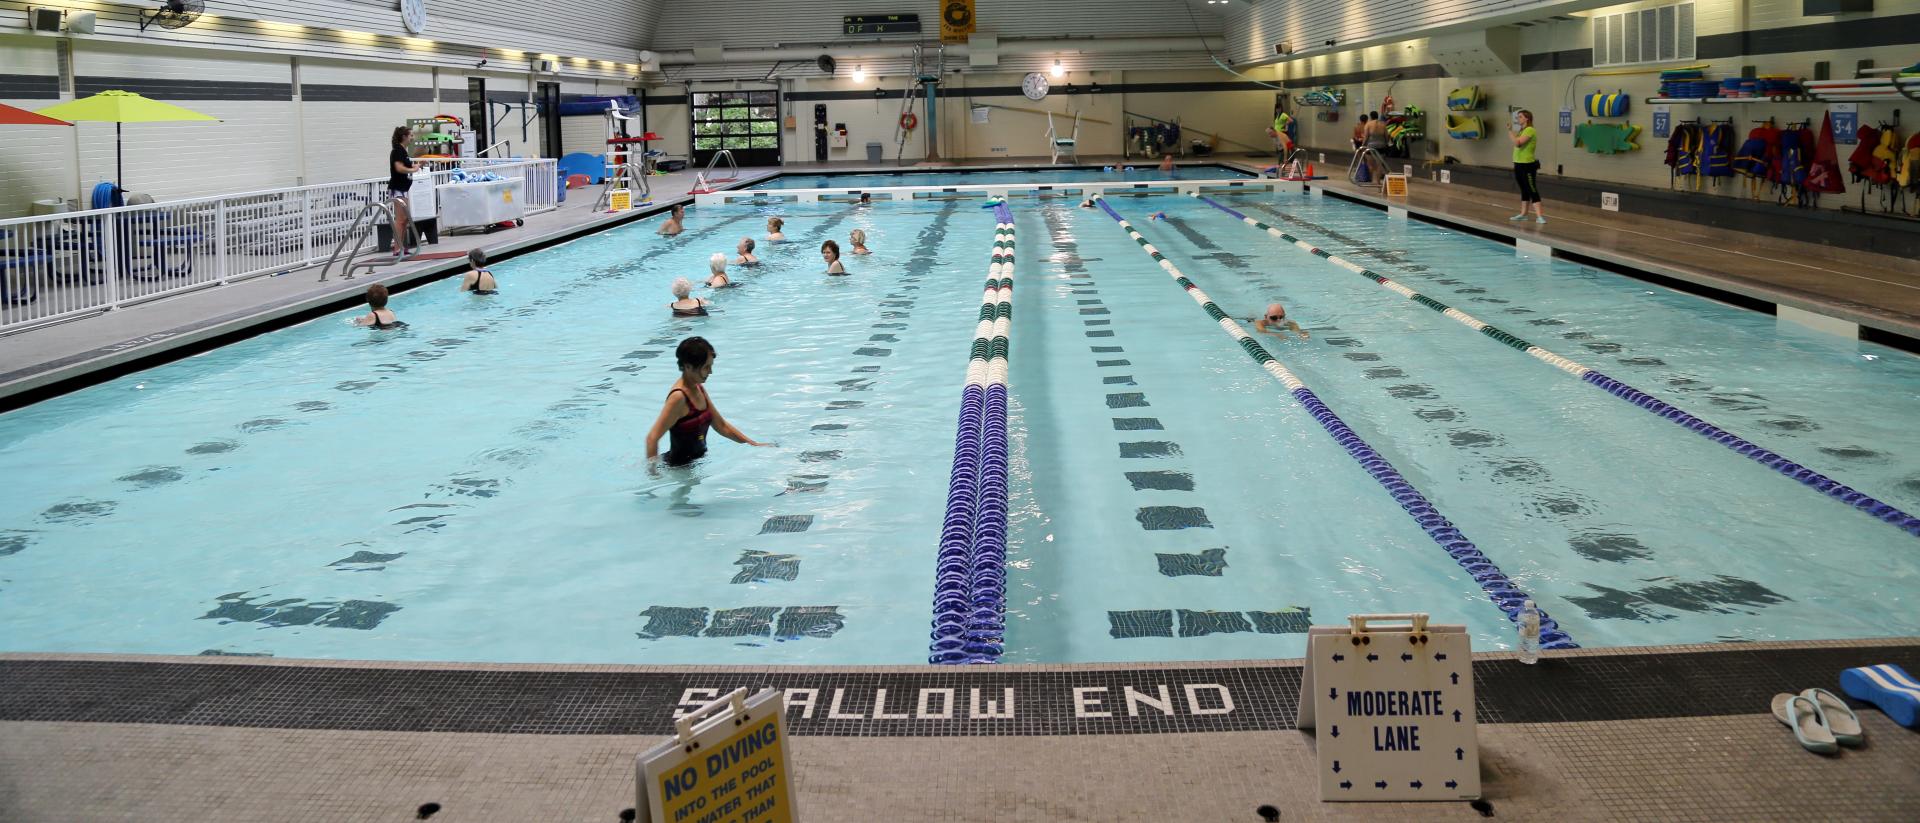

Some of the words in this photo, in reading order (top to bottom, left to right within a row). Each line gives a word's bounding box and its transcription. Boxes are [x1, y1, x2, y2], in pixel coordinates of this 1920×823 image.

[1656, 118, 1667, 130] 5-7
[1834, 119, 1852, 134] 3-4
[672, 687, 1014, 719] SALLOW
[1073, 683, 1235, 717] END
[1347, 690, 1444, 717] MODERATE
[1373, 725, 1421, 751] LANE
[664, 767, 697, 801] NO
[706, 722, 777, 779] DIVING
[674, 796, 706, 822] INTO
[711, 777, 737, 800] THE
[741, 757, 775, 783] POOL
[745, 774, 776, 801] THAT
[742, 796, 775, 823] THAN
